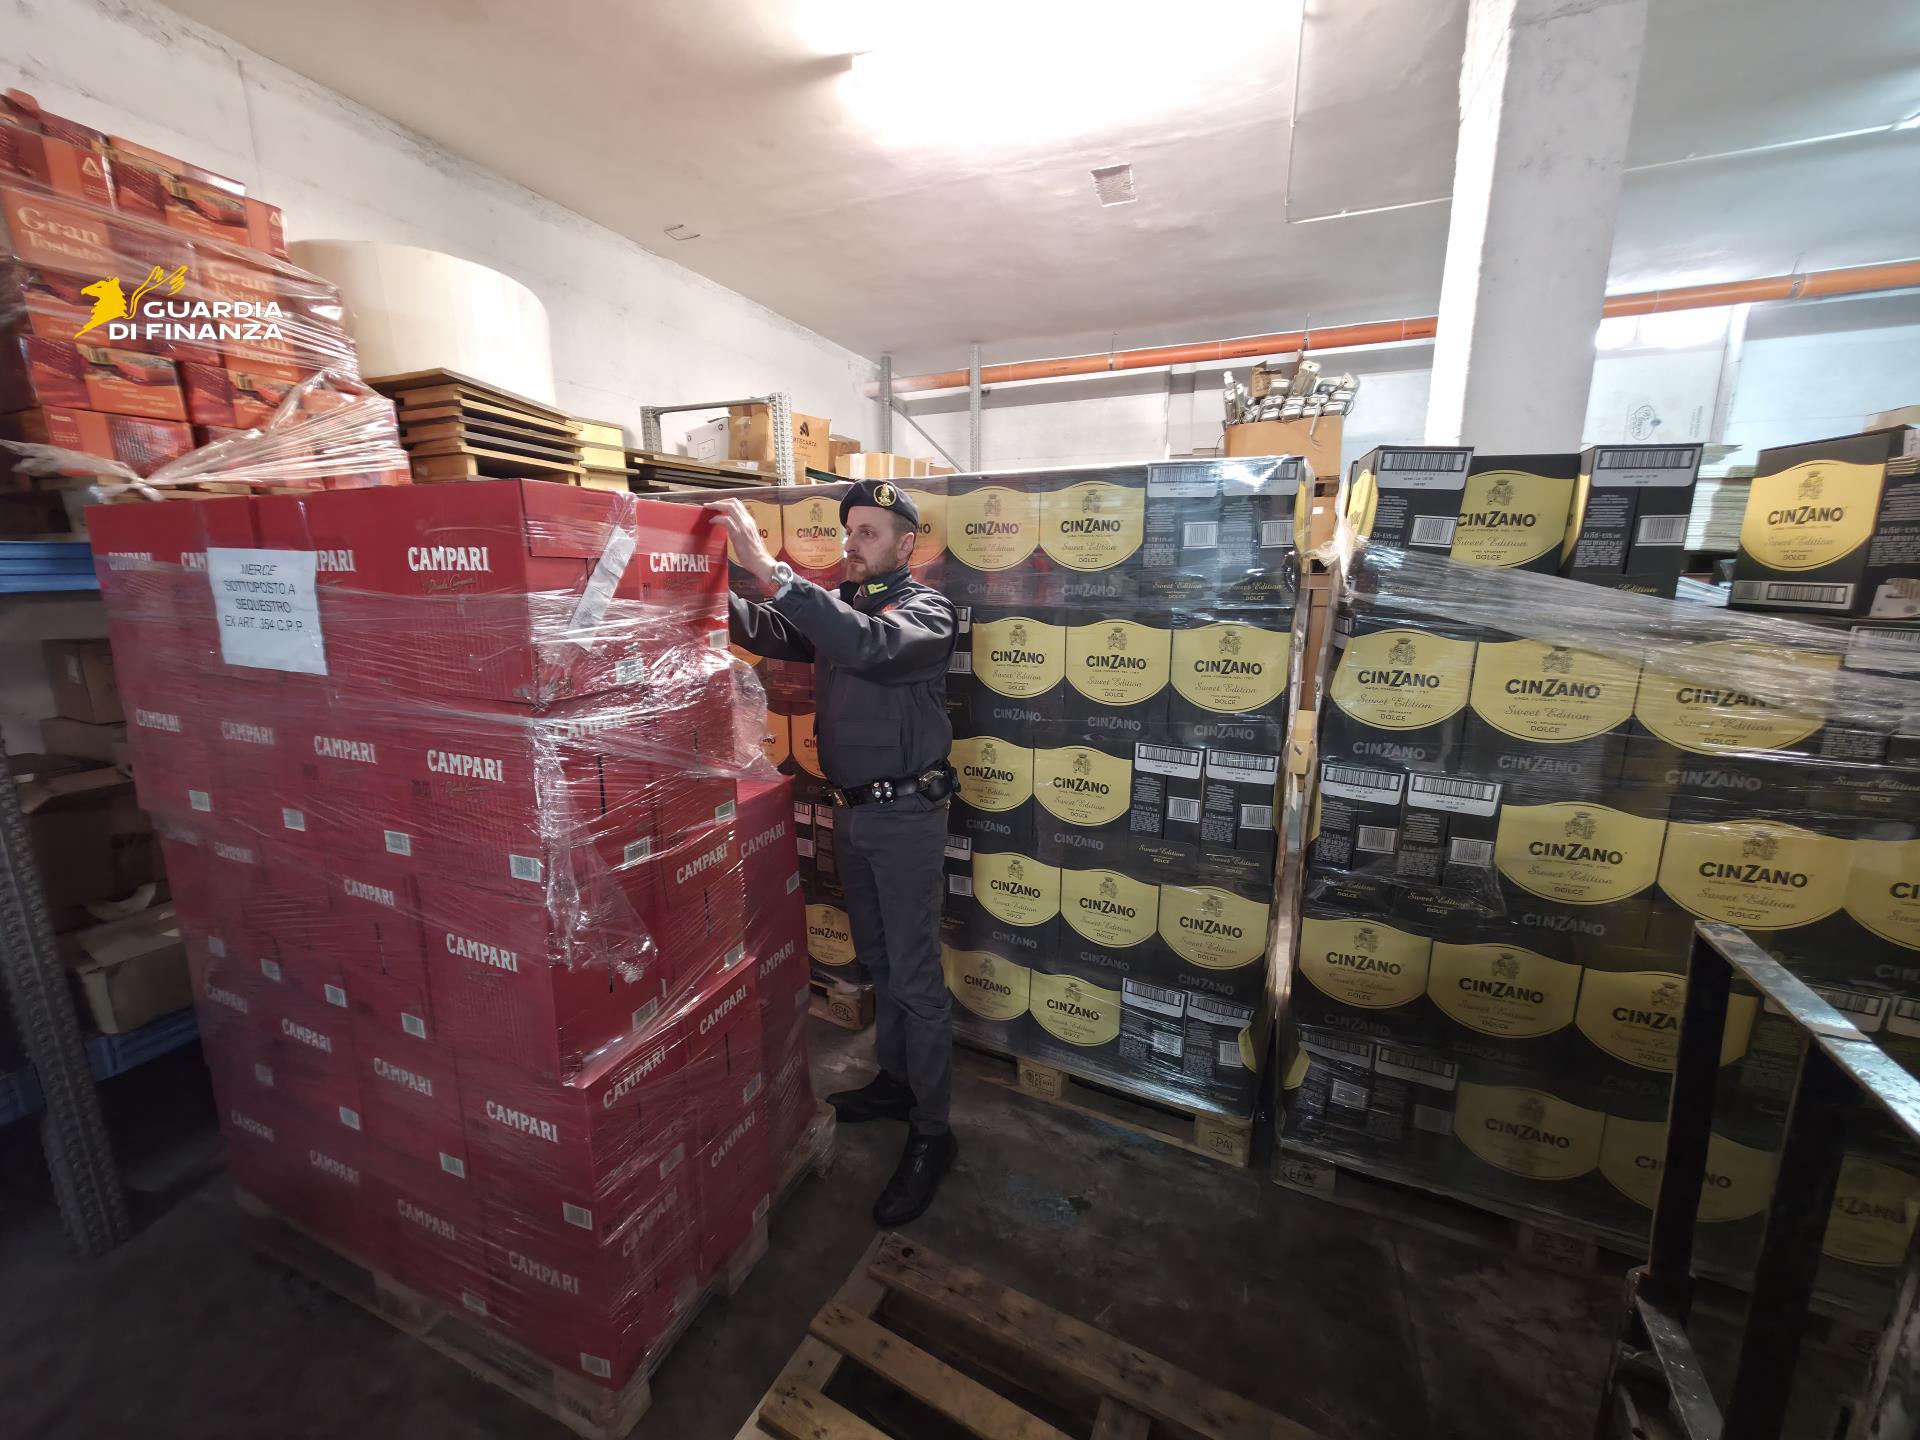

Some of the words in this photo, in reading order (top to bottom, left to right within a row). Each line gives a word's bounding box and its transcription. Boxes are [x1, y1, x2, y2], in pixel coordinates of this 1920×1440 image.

[17, 207, 100, 245] Gran
[1060, 518, 1121, 534] CINZANO
[1456, 511, 1537, 527] CINZANO
[1767, 505, 1844, 525] CINZANO
[797, 526, 837, 539] CINZANO
[965, 520, 1020, 536] CINZANO
[241, 564, 278, 576] MERCE
[315, 549, 355, 572] PARI
[408, 546, 488, 571] CAMPARI
[649, 552, 709, 573] CAMPARI
[288, 583, 296, 595] A
[236, 598, 291, 613] SEQUESTRO
[990, 650, 1045, 665] CINZANO
[1085, 654, 1147, 670] CINZANO
[1193, 659, 1263, 676] CINZANO
[1357, 670, 1440, 688] CINZANO
[1505, 679, 1601, 699] CINZANO
[135, 709, 181, 732] CAMPARI
[1530, 725, 1560, 733] DOLCE
[221, 720, 275, 745] CAMPARI
[314, 736, 377, 764] CAMPARI
[427, 749, 504, 782] CAMPARI
[963, 765, 1015, 782] CINZANO
[1053, 776, 1110, 795] CINZANO
[740, 820, 786, 860] CAMPARI
[1529, 841, 1623, 864] CINZANO
[676, 844, 728, 885] CAMPARI
[1699, 862, 1808, 888] CINZANO
[344, 878, 395, 906] CAMPARI
[990, 879, 1041, 899] CINZANO
[1079, 897, 1136, 918] CINZANO
[809, 926, 849, 942] CINZANO
[1179, 916, 1243, 939] CINZANO
[446, 933, 519, 973] CAMPARI
[759, 940, 795, 979] AMPARI
[1325, 951, 1401, 975] CINZANO
[963, 974, 1011, 996] CINZANO
[1458, 977, 1545, 1004] CINZANO
[700, 984, 747, 1036] CAMPARI
[1046, 998, 1100, 1021] CINZANO
[1612, 1007, 1677, 1030] CINZA
[282, 1018, 332, 1052] CAMPARI
[373, 1057, 433, 1097] CAMPARI
[602, 1045, 666, 1109] CAMPARI
[487, 1099, 560, 1143] CAMPARI
[1485, 1117, 1571, 1148] CINZANO
[711, 1111, 756, 1168] CAMPARI
[310, 1150, 359, 1184] CAMPARI
[397, 1199, 456, 1240] CAMPARI
[508, 1250, 580, 1295] CAMPARI
